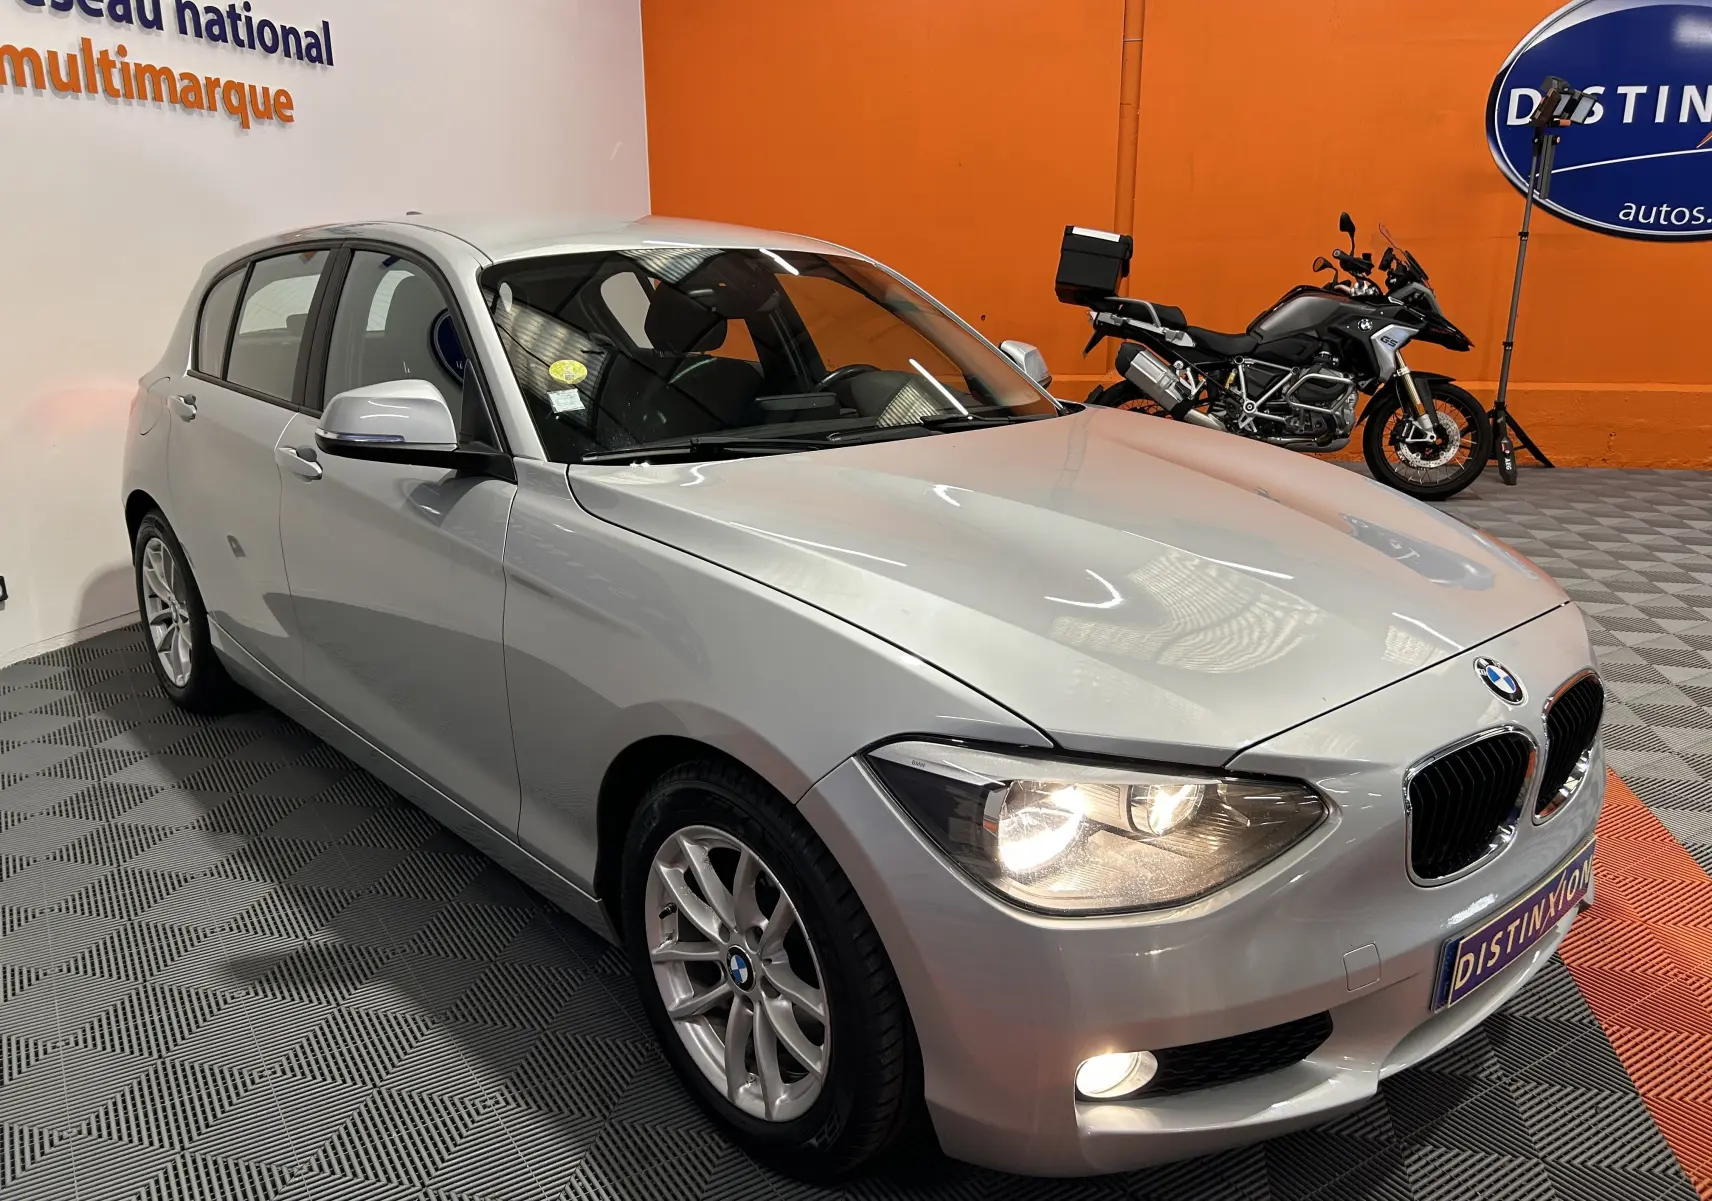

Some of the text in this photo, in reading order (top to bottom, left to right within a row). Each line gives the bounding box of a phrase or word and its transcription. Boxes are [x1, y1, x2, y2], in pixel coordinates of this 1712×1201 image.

[175, 0, 335, 67] national
[0, 36, 295, 129] multimarque
[1506, 85, 1712, 126] DSTIN
[1380, 335, 1398, 348] GS
[1504, 457, 1512, 471] AEG
[1453, 853, 1593, 991] DISTINXION
